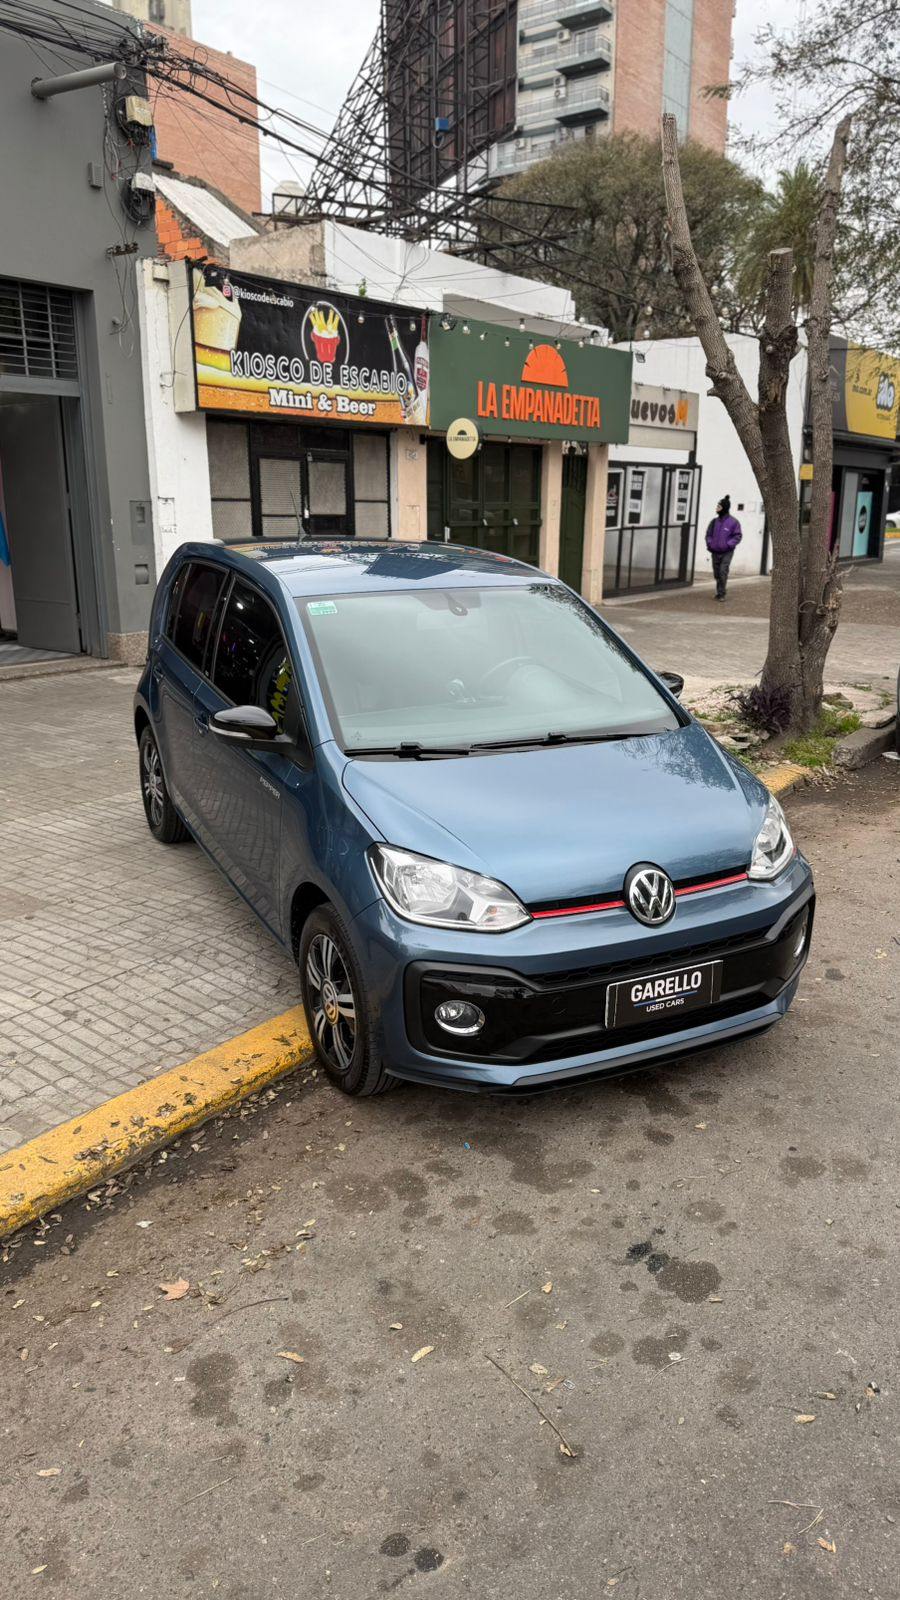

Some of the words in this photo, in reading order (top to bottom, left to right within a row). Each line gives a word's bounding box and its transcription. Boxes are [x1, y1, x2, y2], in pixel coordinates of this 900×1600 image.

[233, 286, 294, 307] @kioscodeescabio
[230, 350, 305, 383] KIOSCO
[309, 360, 334, 388] DE
[339, 364, 407, 396] ESCABIO
[268, 387, 314, 410] Mini
[317, 393, 333, 411] &
[336, 395, 376, 415] Beer
[477, 380, 498, 419] LA
[501, 384, 601, 428] EMPANADETTA
[630, 398, 676, 424] uevos
[630, 971, 702, 1002] GARELLO
[646, 1002, 665, 1013] USED
[666, 998, 685, 1009] CARS
